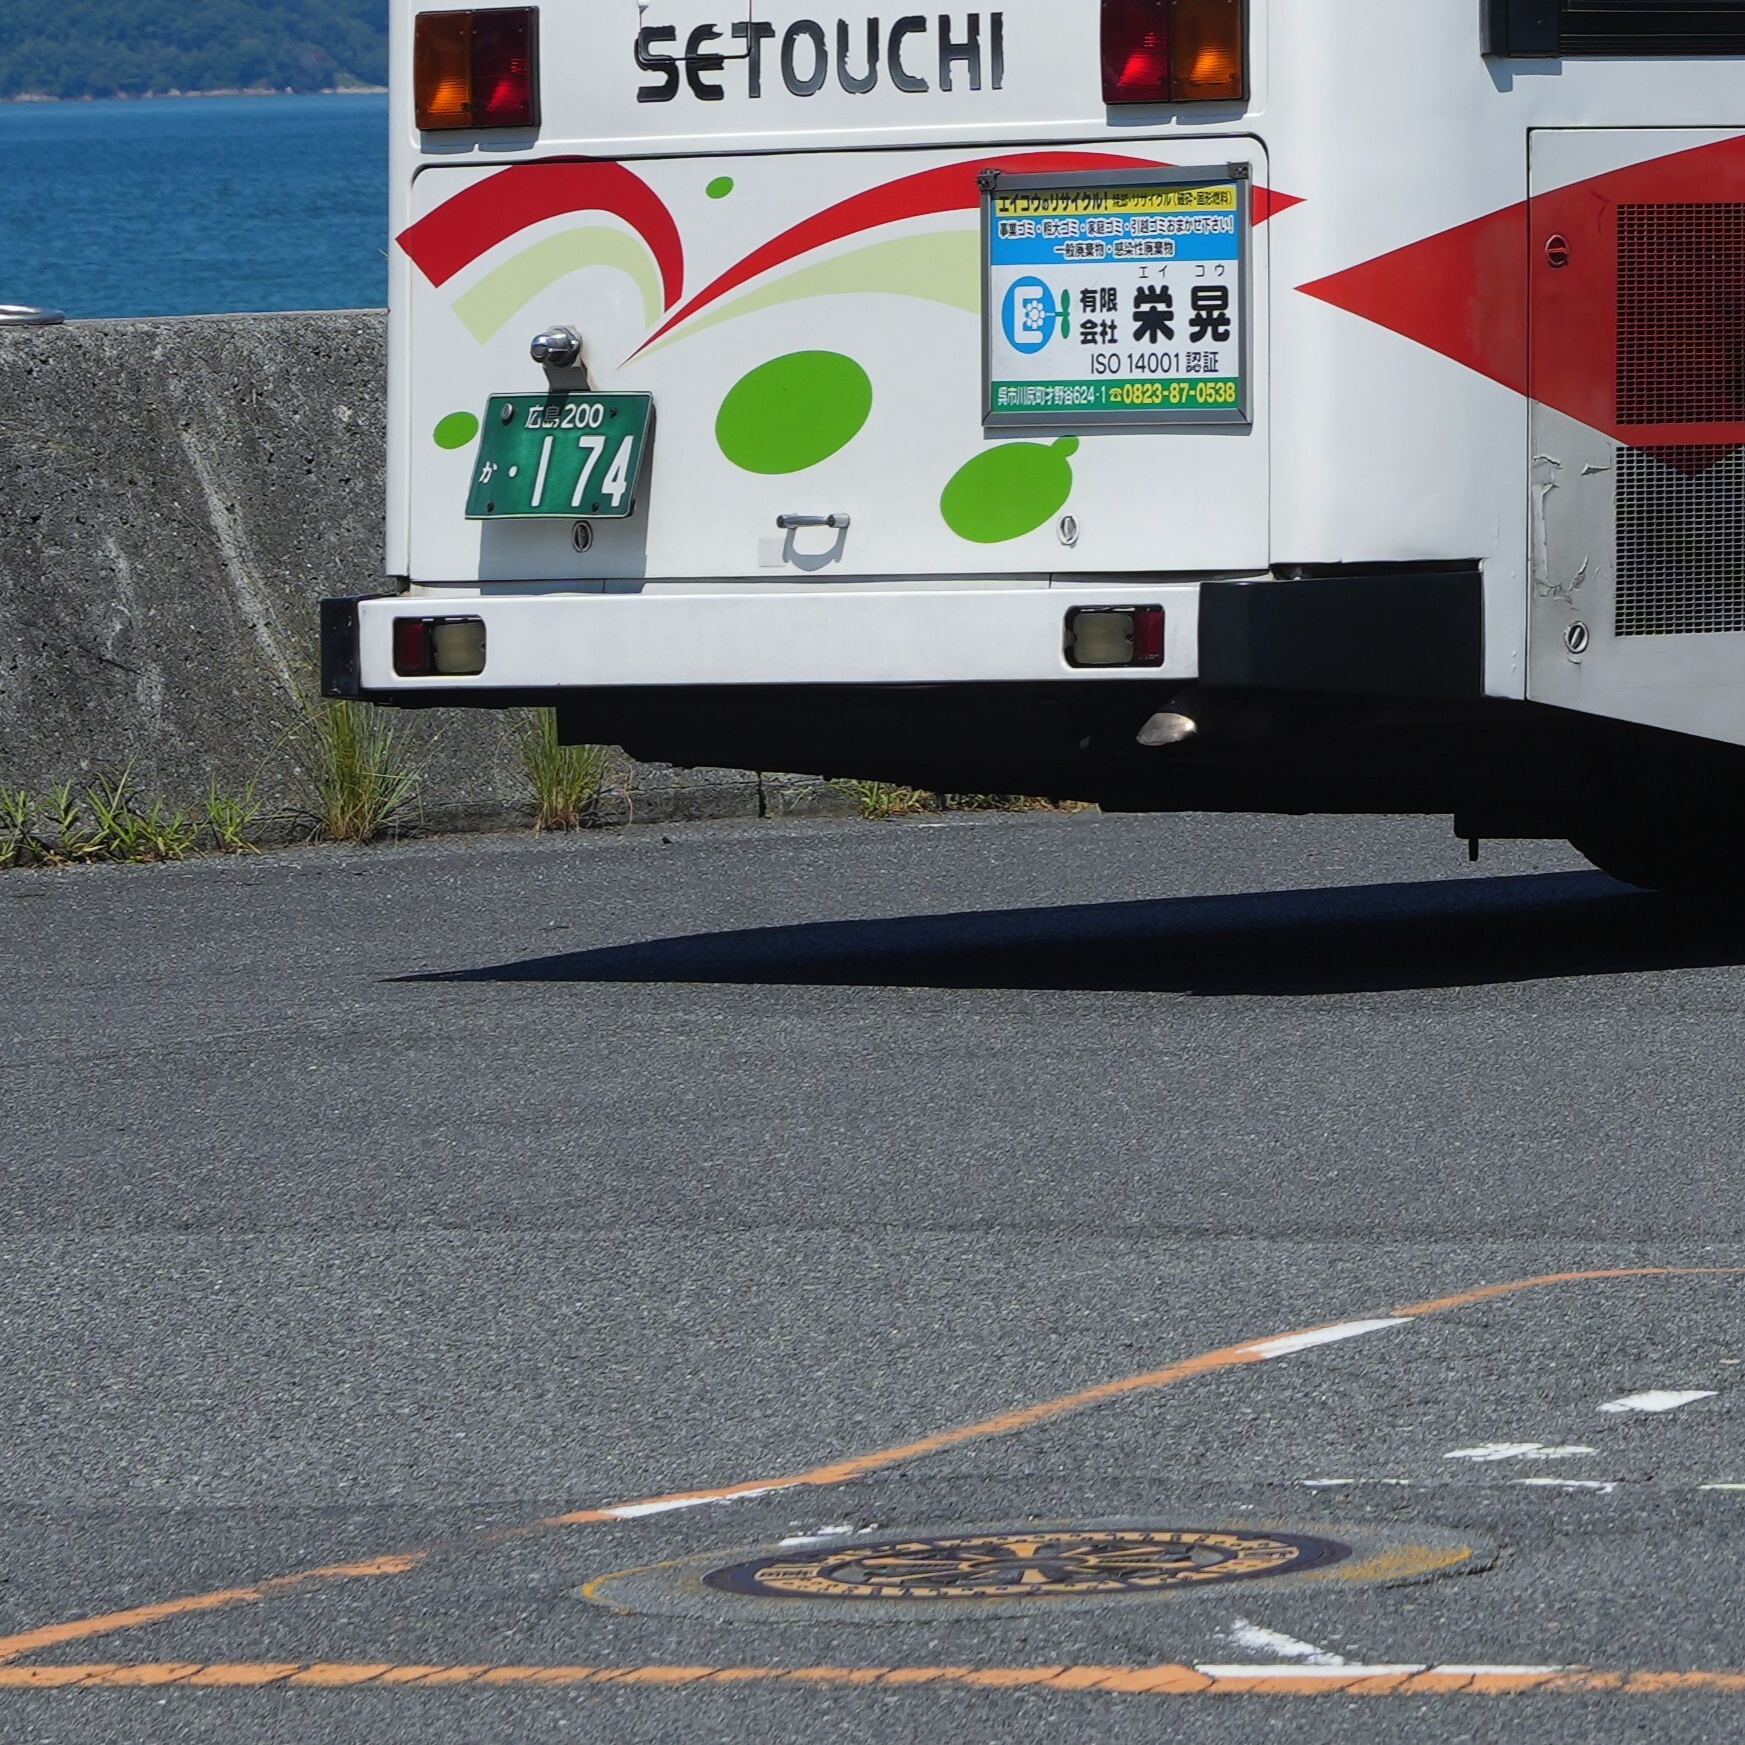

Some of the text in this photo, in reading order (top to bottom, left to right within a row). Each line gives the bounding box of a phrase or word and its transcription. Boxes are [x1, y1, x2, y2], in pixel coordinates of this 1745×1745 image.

[634, 11, 1004, 103] SETOUCHI
[1090, 351, 1219, 375] ISO 14001 認証
[1122, 381, 1236, 405] 0823-87-0538
[478, 460, 498, 484] か
